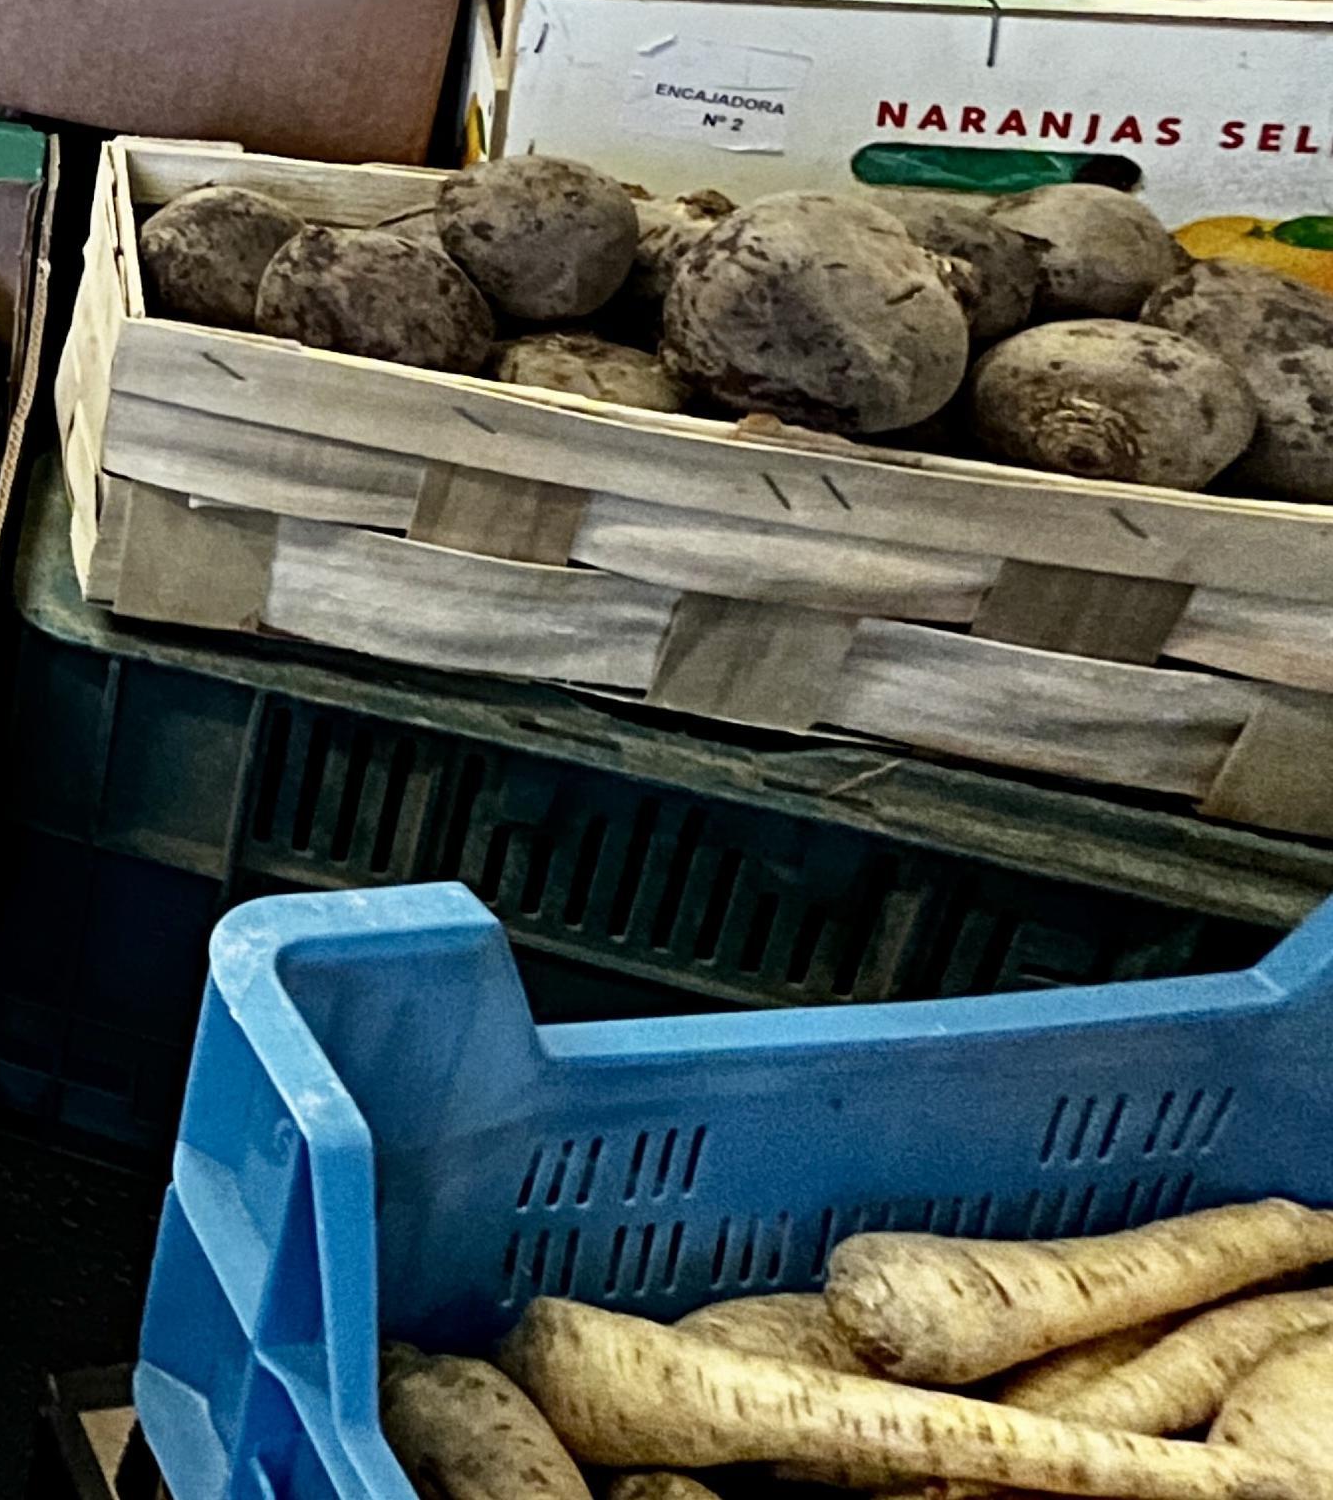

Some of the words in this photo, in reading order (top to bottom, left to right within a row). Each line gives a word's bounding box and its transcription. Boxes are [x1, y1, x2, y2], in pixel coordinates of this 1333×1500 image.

[654, 82, 785, 116] ENCAJADORA
[730, 117, 745, 132] 2
[876, 100, 1182, 147] NARANJAS
[1218, 120, 1333, 155] SEL
